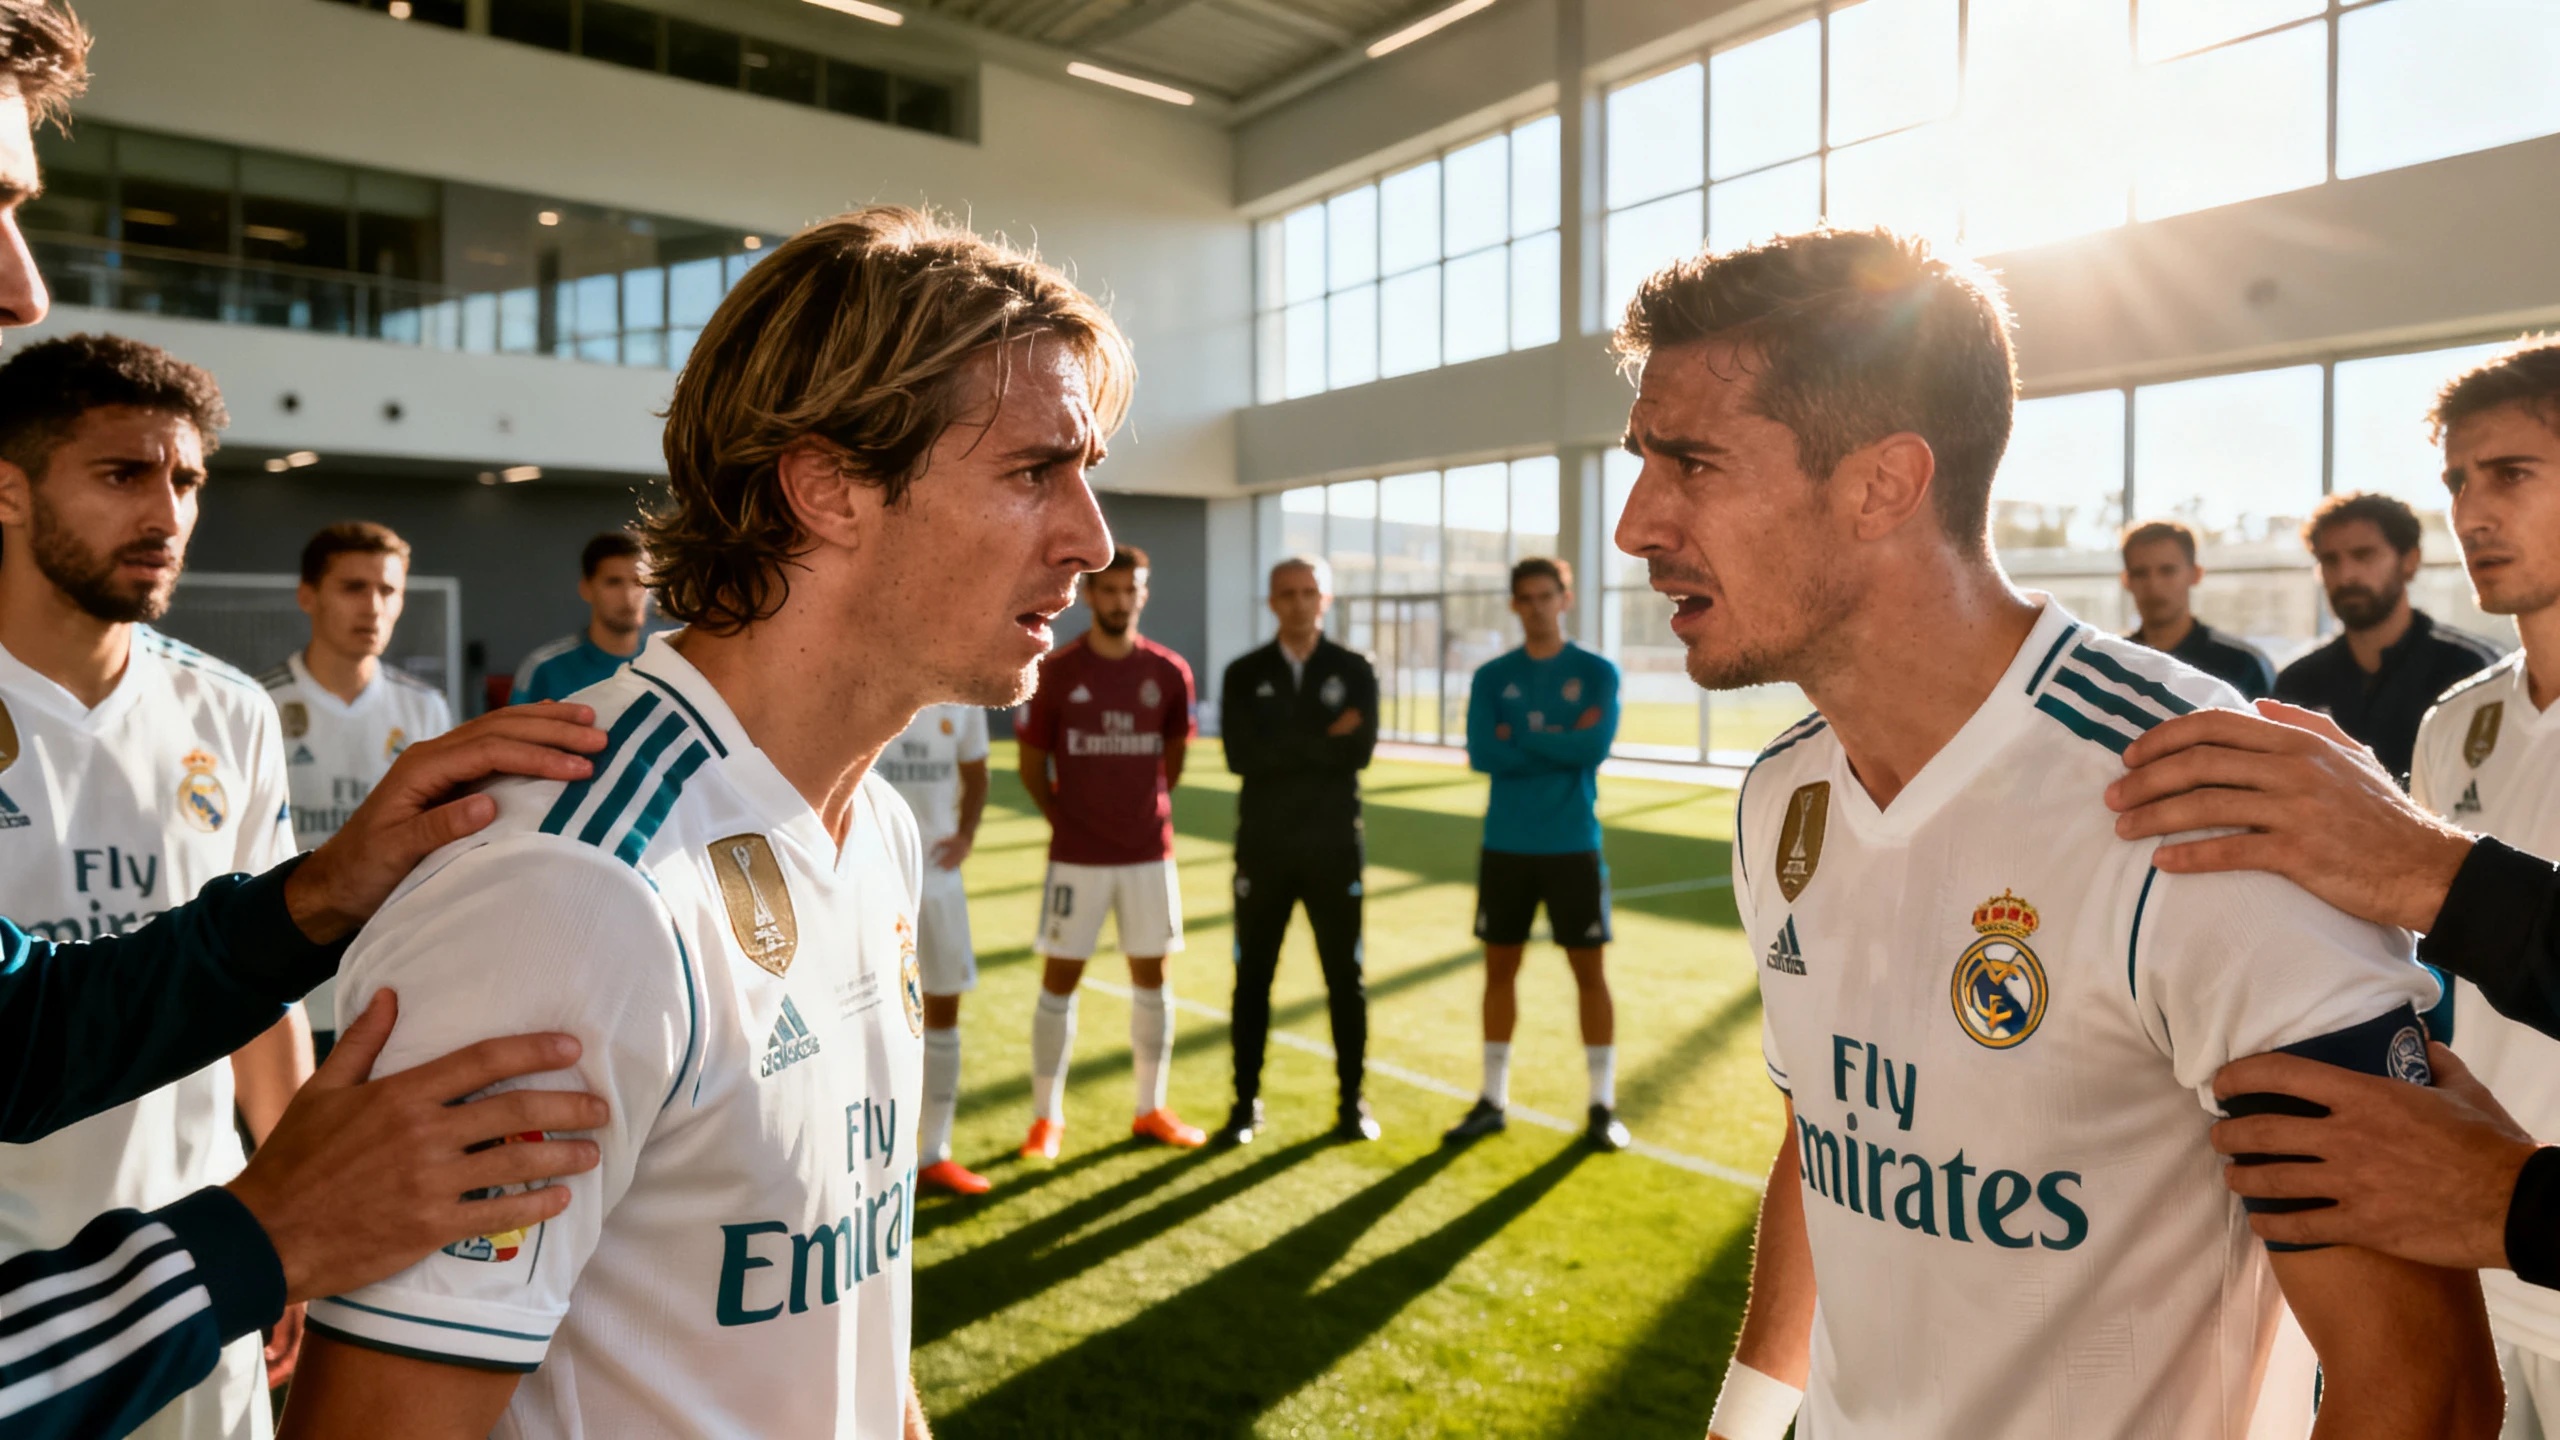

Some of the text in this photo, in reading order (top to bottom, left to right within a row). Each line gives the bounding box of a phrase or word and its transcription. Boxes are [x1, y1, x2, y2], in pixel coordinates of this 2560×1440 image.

[73, 846, 157, 898] Fly
[1832, 1034, 1917, 1132] Fly
[846, 1097, 896, 1174] Fly
[1796, 1111, 2089, 1251] mirates
